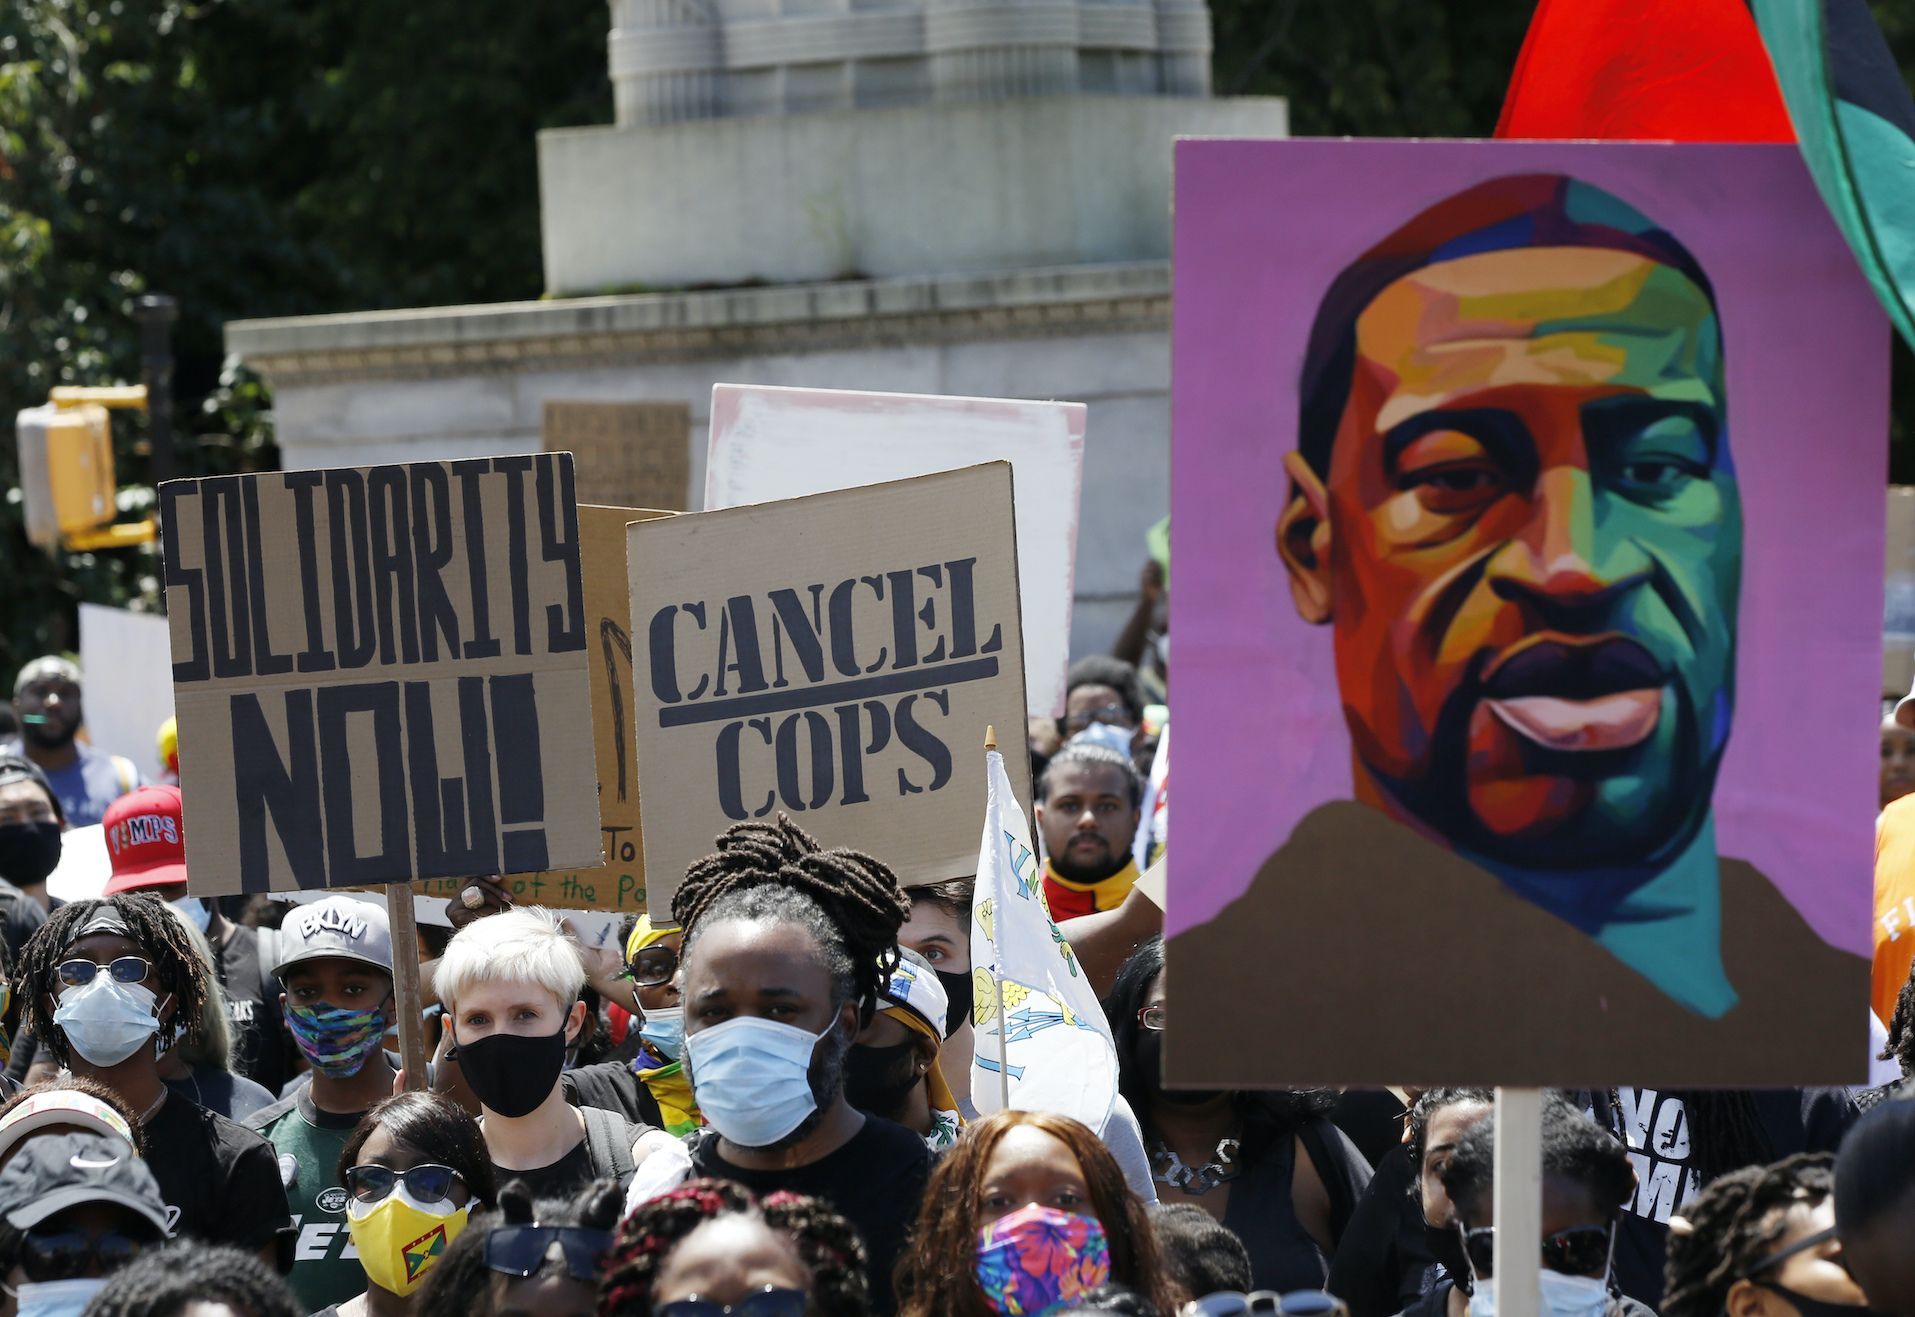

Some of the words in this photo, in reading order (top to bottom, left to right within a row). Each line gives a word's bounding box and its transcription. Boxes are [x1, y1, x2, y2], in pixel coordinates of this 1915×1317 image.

[159, 453, 587, 682] SOLIDARITY
[649, 556, 1003, 704] CANCEL
[230, 672, 550, 896] NOW!
[715, 688, 953, 821] COPS
[558, 874, 597, 902] the
[600, 826, 636, 862] To
[299, 907, 367, 940] BKLYN
